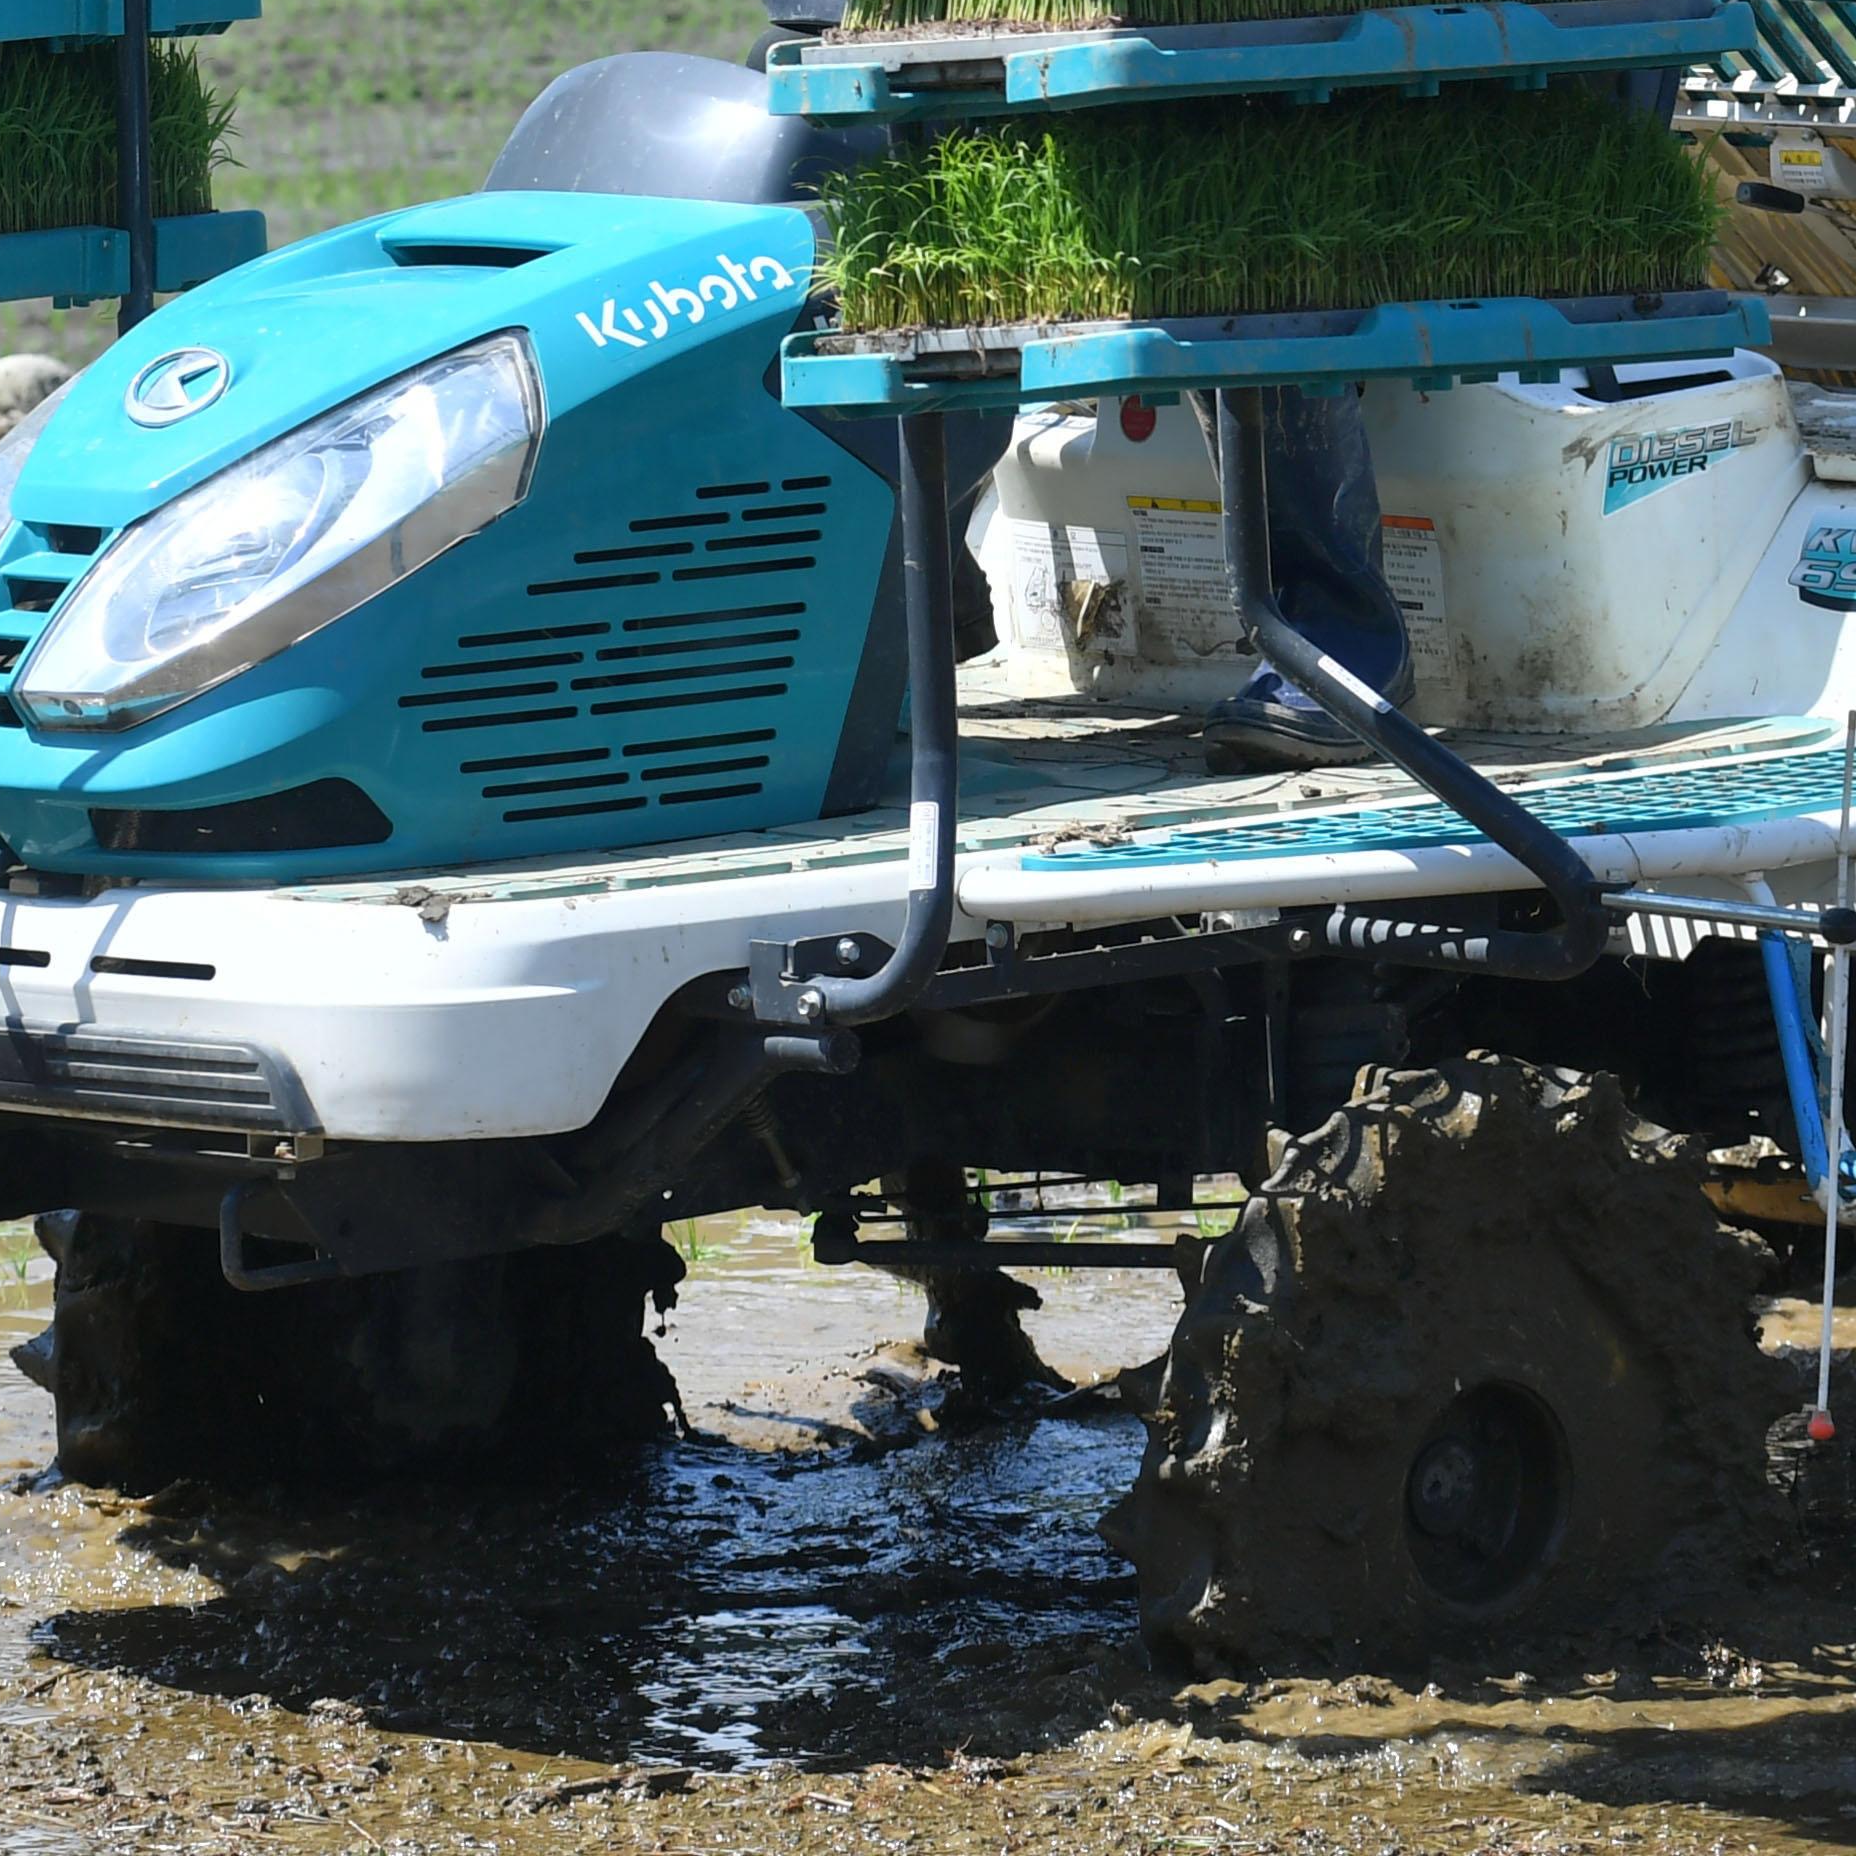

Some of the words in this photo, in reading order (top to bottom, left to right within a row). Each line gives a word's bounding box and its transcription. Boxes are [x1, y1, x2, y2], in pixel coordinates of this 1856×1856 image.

[575, 253, 795, 348] Kubota
[1610, 420, 1757, 469] DIESEL
[1608, 454, 1708, 488] POWER
